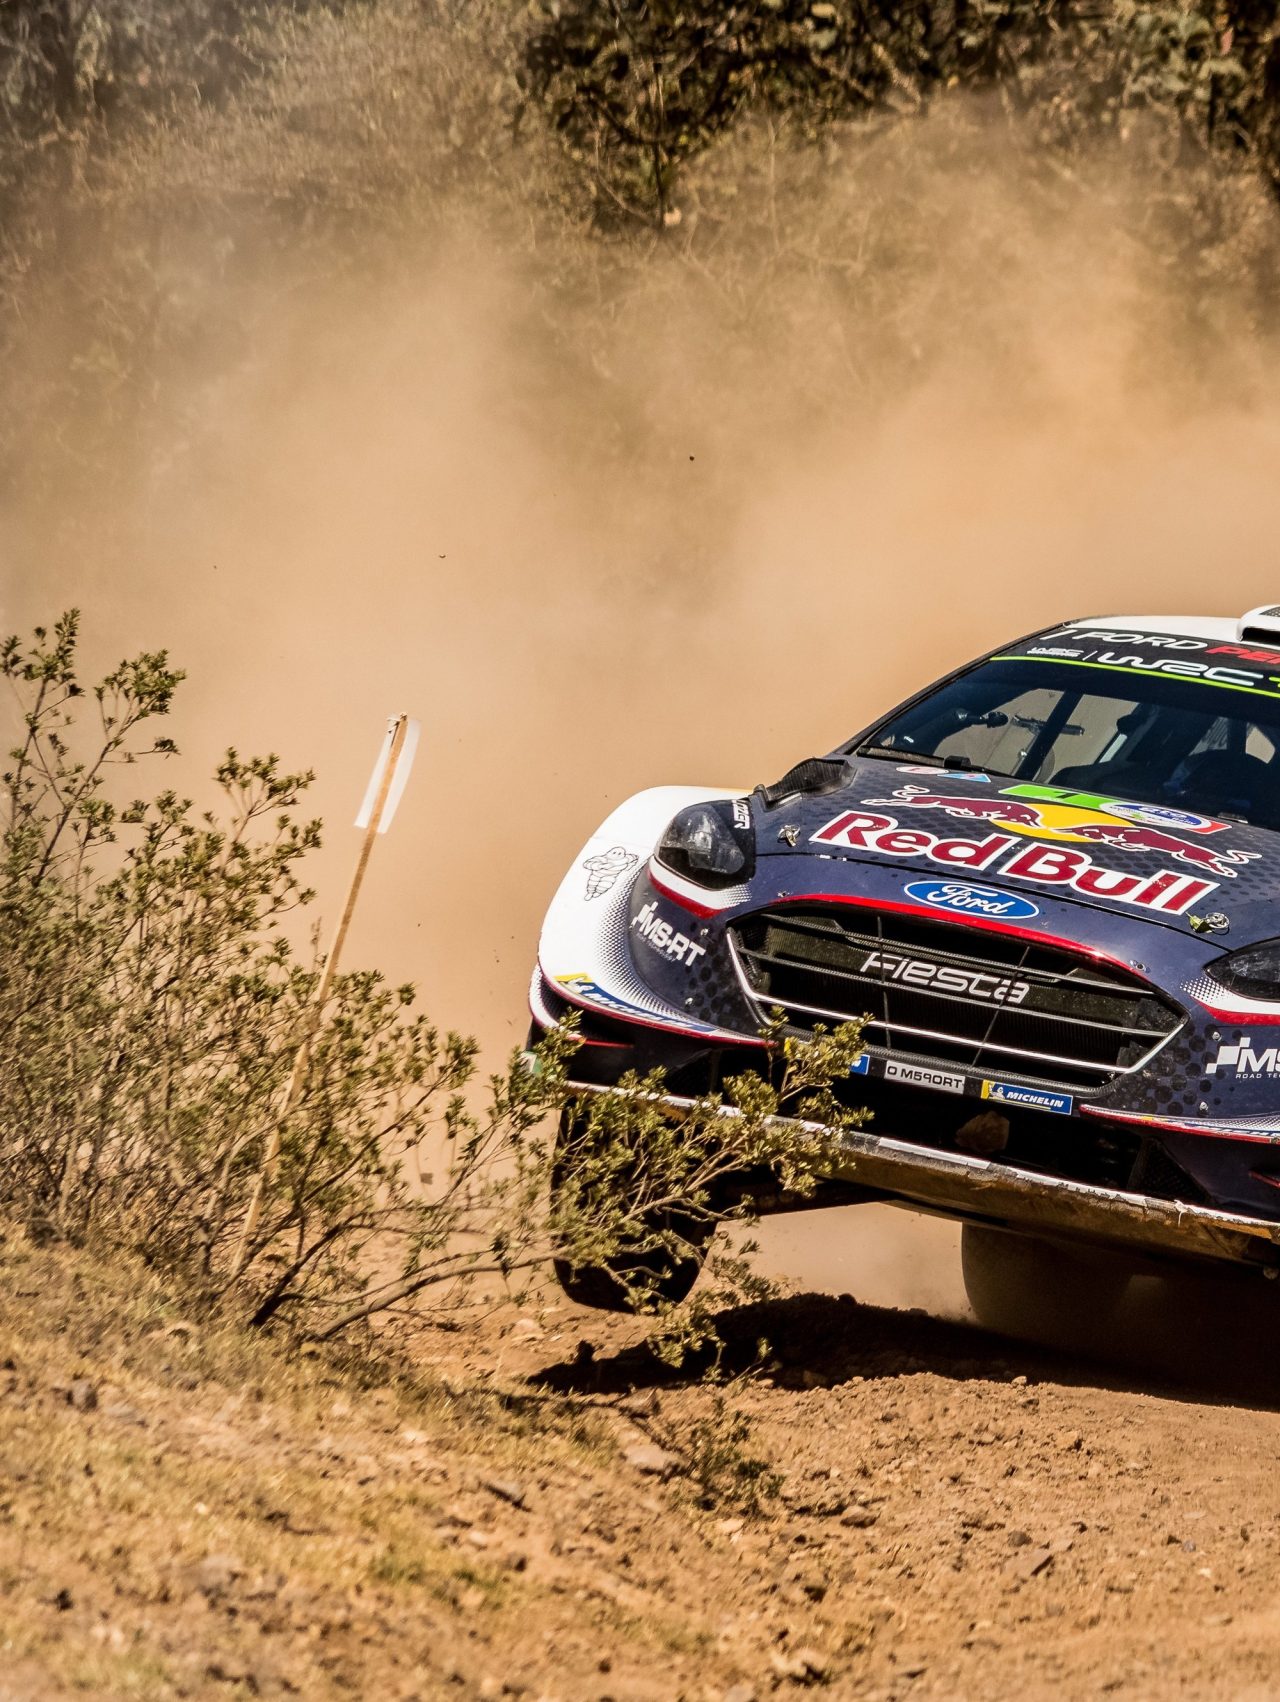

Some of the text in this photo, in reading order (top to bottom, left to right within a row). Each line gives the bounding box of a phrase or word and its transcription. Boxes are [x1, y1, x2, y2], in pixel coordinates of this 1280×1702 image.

[1073, 631, 1208, 650] FORD
[1097, 651, 1264, 687] WRC
[813, 811, 1212, 911] Red Bull
[927, 883, 1015, 915] Ford
[1006, 1091, 1064, 1109] MICHELIN
